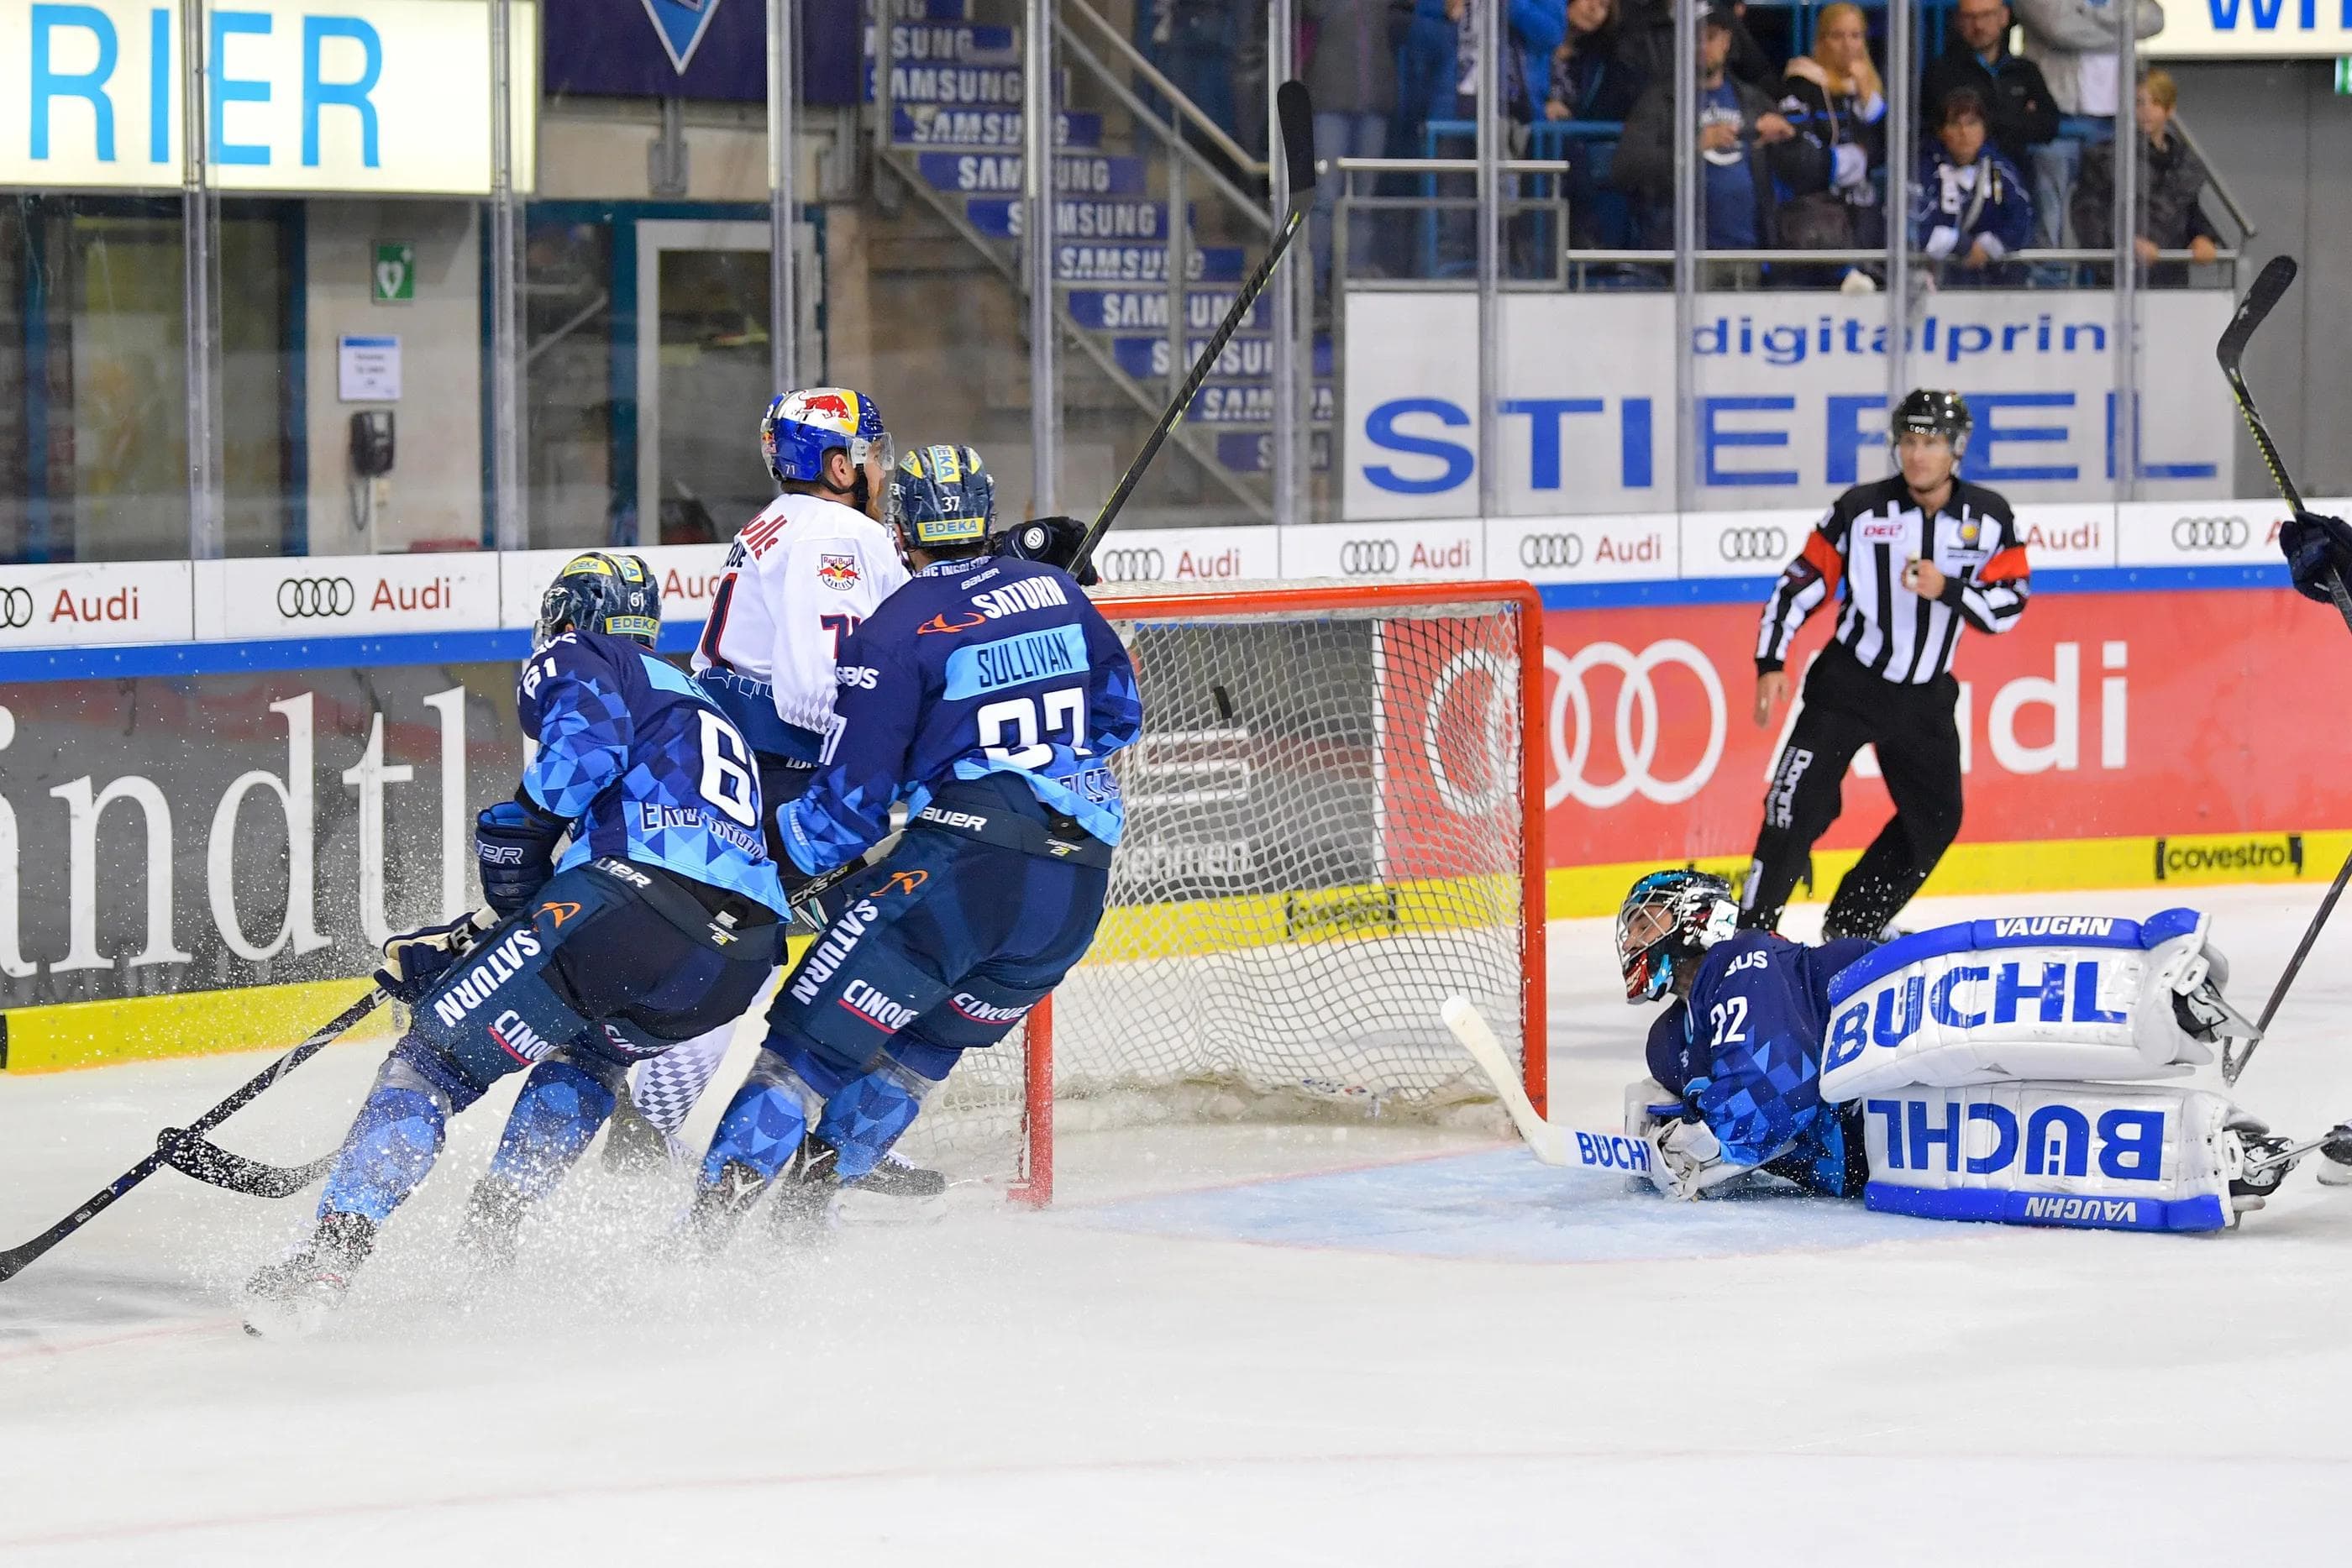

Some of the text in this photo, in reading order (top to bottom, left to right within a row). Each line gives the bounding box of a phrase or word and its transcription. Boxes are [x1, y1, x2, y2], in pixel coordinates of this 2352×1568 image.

[912, 111, 1070, 144] SAMSUG
[958, 155, 1110, 192] SAMUNG
[1008, 201, 1157, 237] SMSUNG
[1362, 391, 2217, 496] STIEFEL
[785, 464, 795, 475] 71
[941, 496, 961, 512] 37
[925, 520, 979, 535] EDEKA
[2025, 522, 2100, 551] Audi
[1176, 549, 1241, 578] Audi
[1410, 540, 1471, 569] Audi
[1595, 534, 1662, 564] Audi
[370, 577, 452, 612] Audi
[961, 568, 1000, 590] BAUER
[50, 586, 139, 623] Audi
[630, 591, 644, 613] 61
[971, 575, 1069, 619] SATURN
[612, 616, 656, 631] EDEKA
[977, 632, 1074, 688] SULLIVAN
[698, 709, 763, 827] 6
[2167, 841, 2286, 871] covestro
[1994, 916, 2113, 938] VAUGHN
[790, 899, 879, 1006] SATURN
[433, 929, 542, 1027] SATURN
[1710, 996, 1748, 1046] 32
[1867, 1099, 2166, 1182] BÜCHL
[2024, 1196, 2136, 1224] VAUGHN
